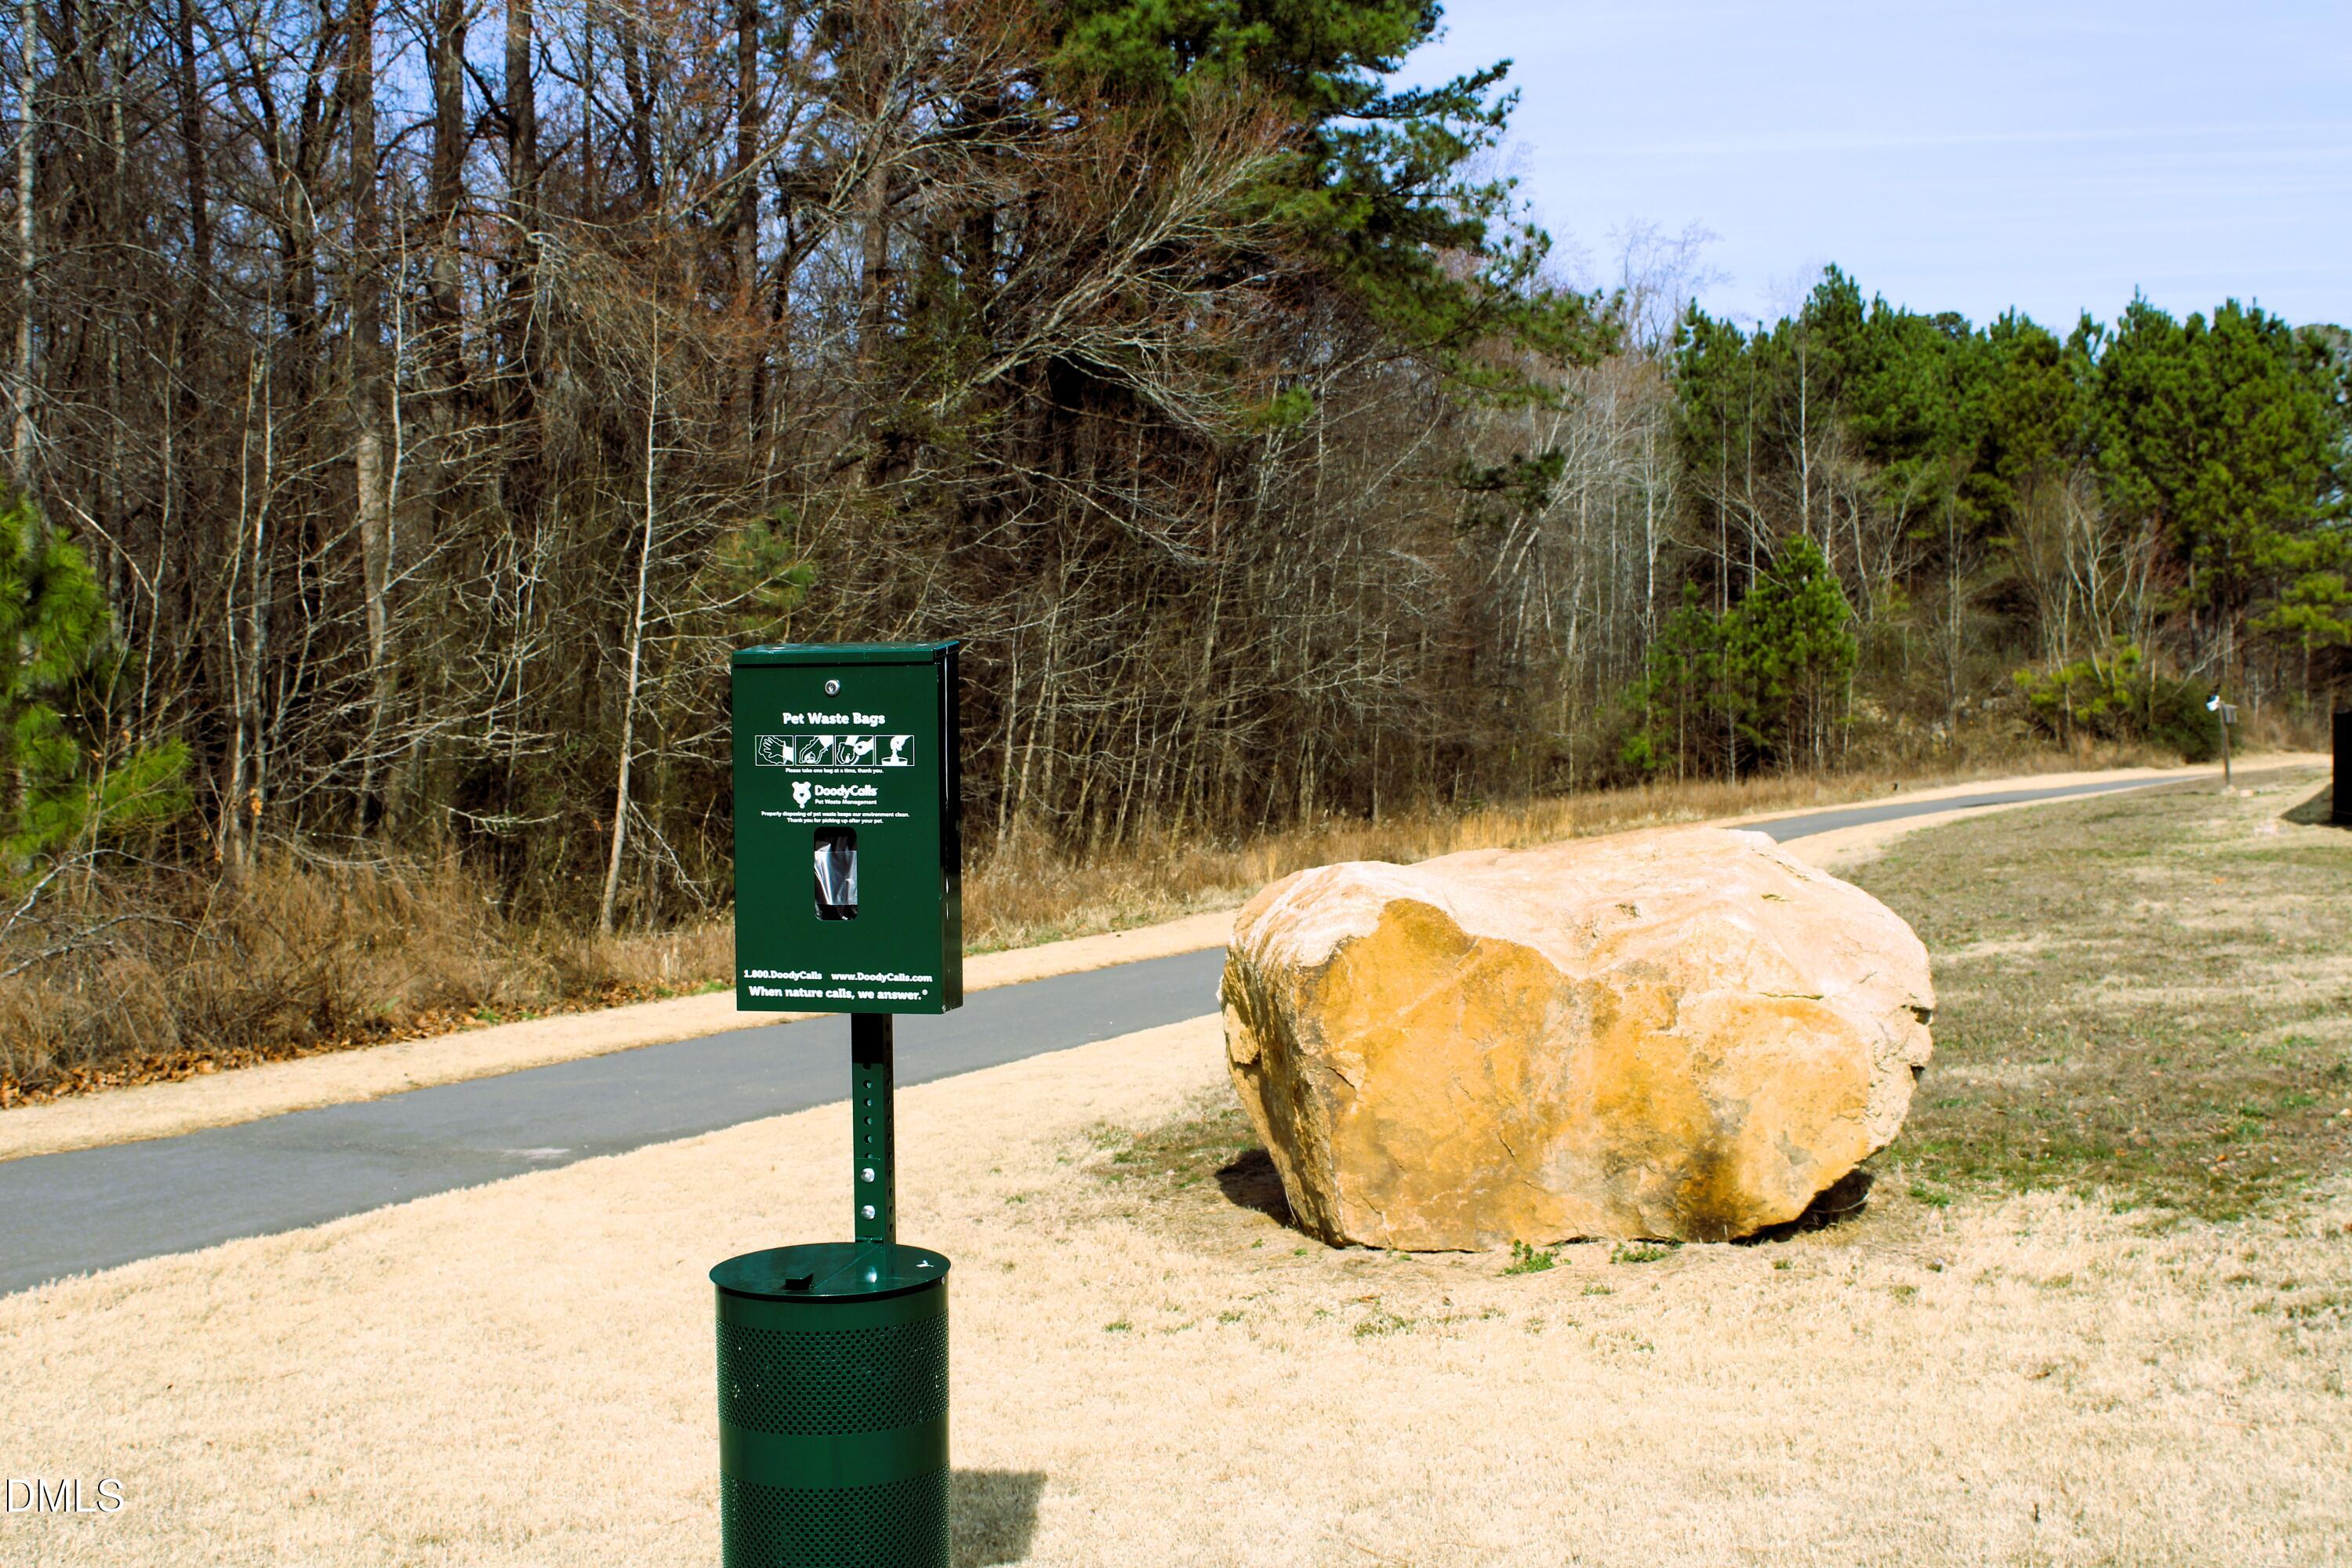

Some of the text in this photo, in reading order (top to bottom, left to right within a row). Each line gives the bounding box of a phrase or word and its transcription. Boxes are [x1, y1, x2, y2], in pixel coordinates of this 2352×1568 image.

[782, 712, 886, 727] Pet Waste Bags
[743, 969, 933, 984] 1.800.DoodyCalls www.DoodyCalls.com
[749, 985, 783, 997] When
[785, 987, 823, 998] nature
[826, 988, 855, 1000] calls,
[858, 990, 875, 1000] we
